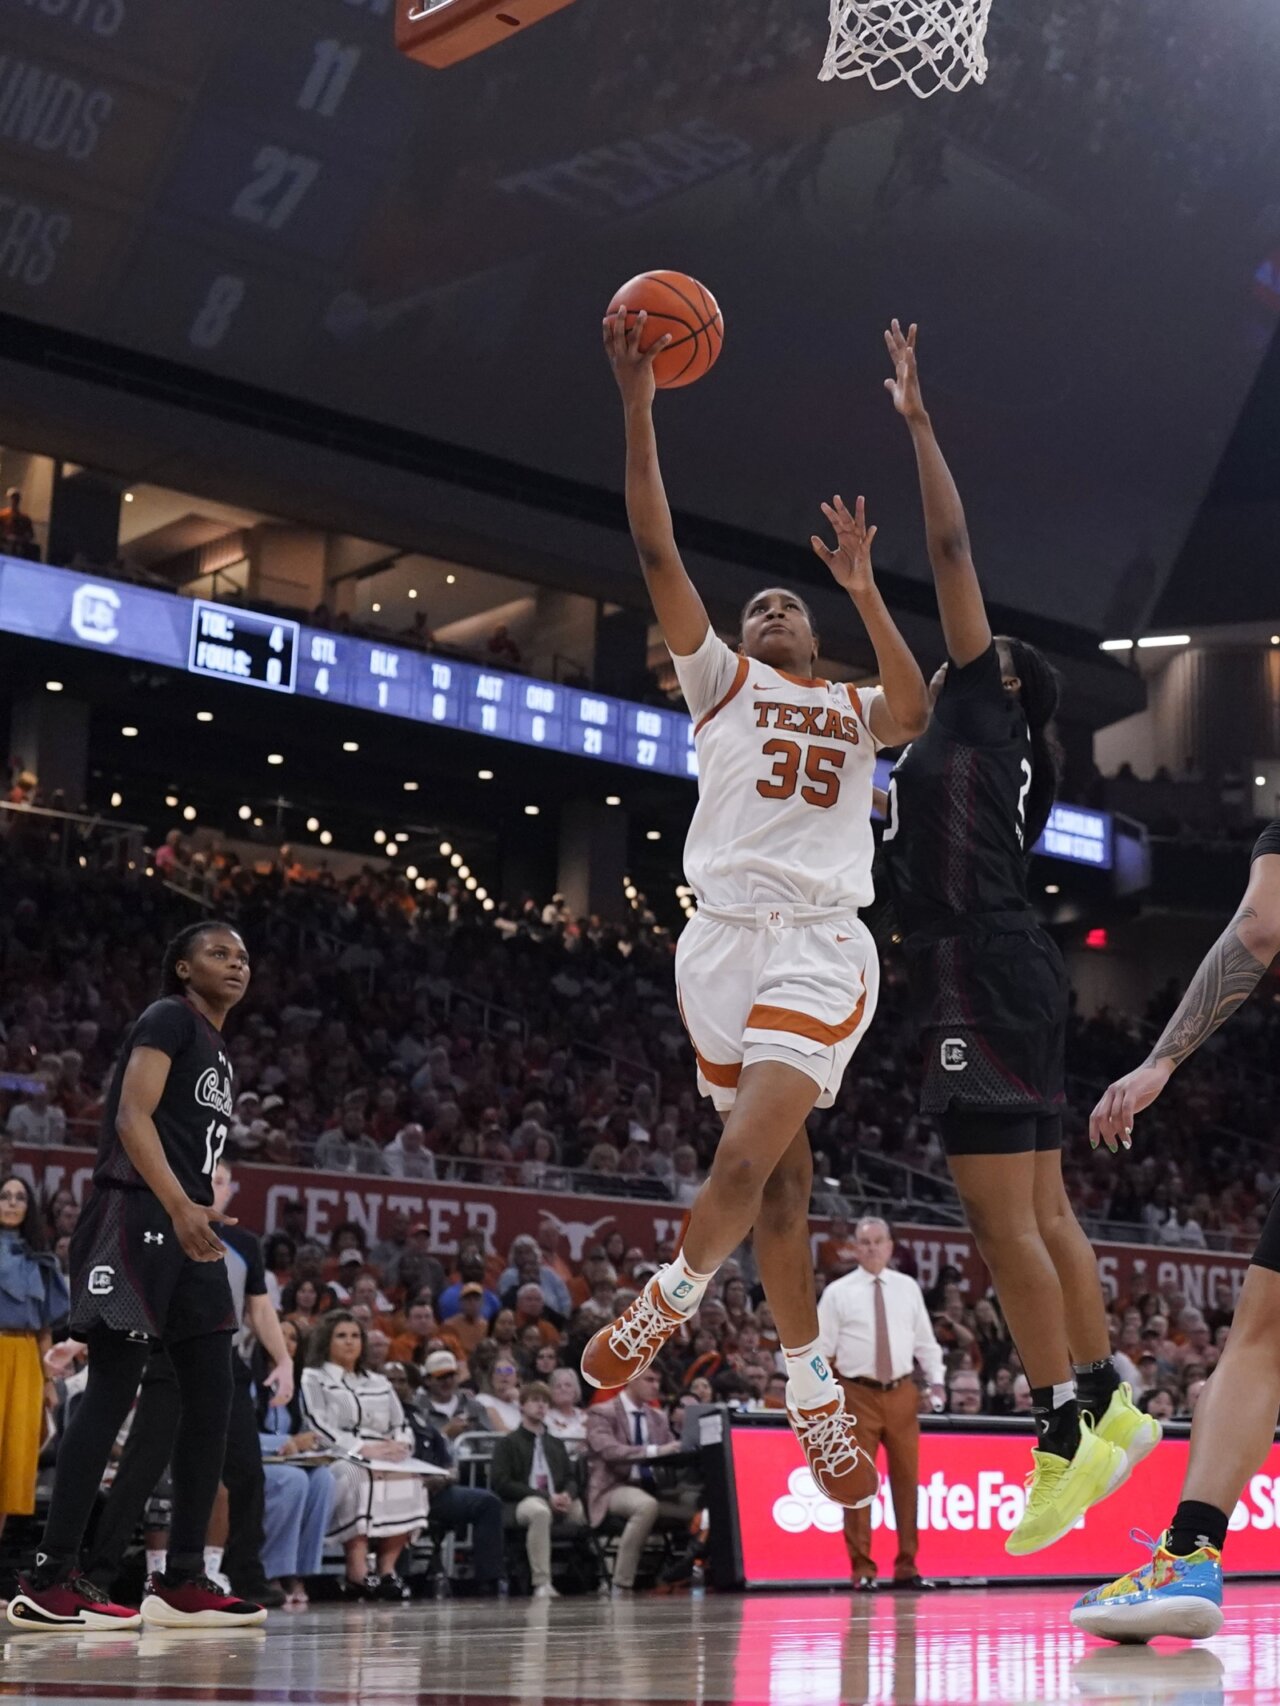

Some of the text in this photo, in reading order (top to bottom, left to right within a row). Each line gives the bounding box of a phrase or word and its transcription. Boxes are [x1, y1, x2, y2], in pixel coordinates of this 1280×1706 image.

[298, 38, 362, 118] 11
[231, 145, 321, 229] 27
[189, 274, 246, 349] 8
[269, 625, 284, 653] 4
[311, 635, 337, 665] STL
[370, 649, 399, 678] BLK
[431, 663, 451, 690] TO
[475, 674, 504, 702] AST
[315, 667, 329, 695] 4
[378, 681, 388, 708] 1
[583, 727, 603, 755] 21
[636, 739, 658, 767] 27
[754, 701, 859, 745] TEXAS
[756, 738, 846, 809] 35
[900, 1238, 970, 1298] HE
